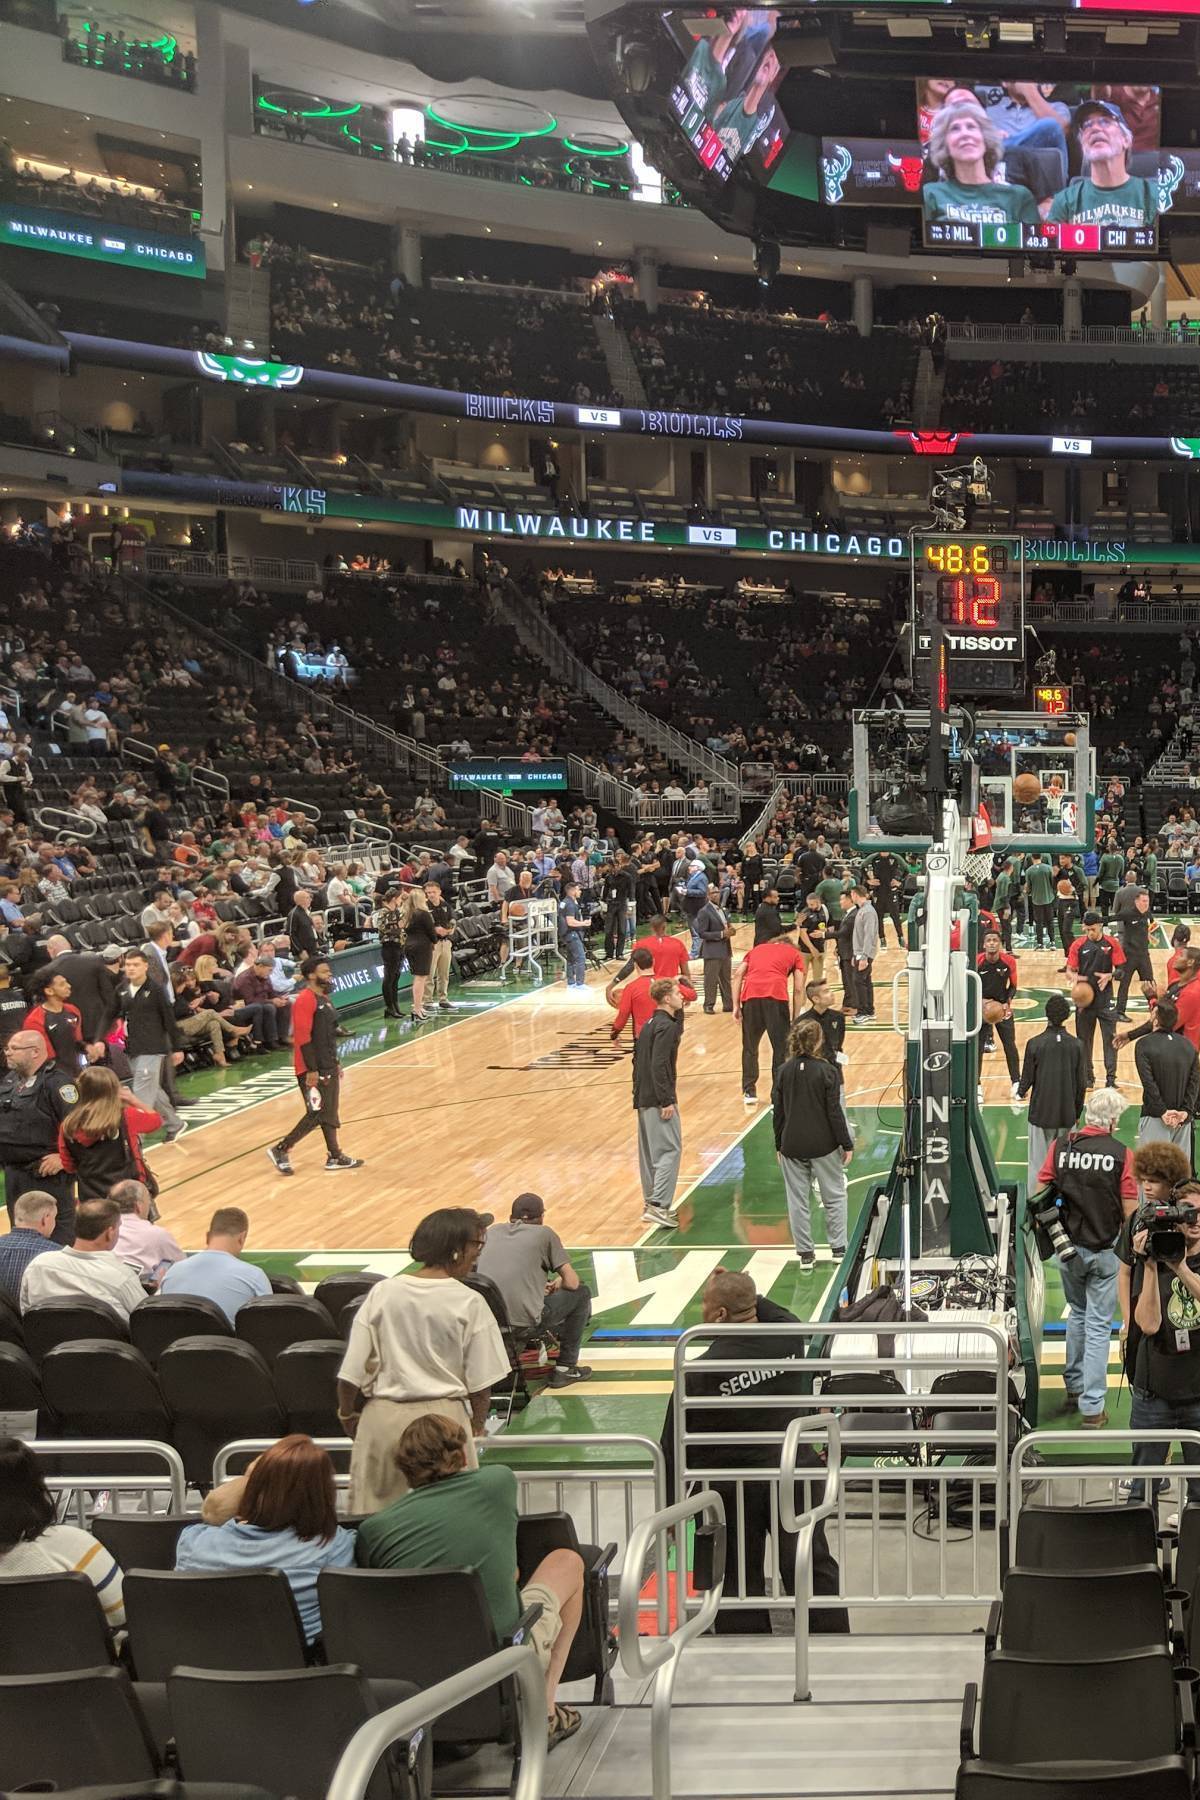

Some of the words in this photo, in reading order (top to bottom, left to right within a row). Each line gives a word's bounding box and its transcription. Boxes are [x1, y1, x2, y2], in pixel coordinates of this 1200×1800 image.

[1073, 204, 1144, 224] MILWAUKEE
[953, 226, 973, 241] MIL
[996, 227, 1007, 242] 0
[1046, 226, 1056, 235] 12
[1075, 229, 1085, 245] 0
[1108, 230, 1126, 245] CHI
[10, 221, 94, 245] MILWAUKEE
[136, 244, 194, 262] CHICAGO
[1026, 236, 1048, 247] 48.8
[466, 393, 555, 424] BUCKS
[590, 411, 608, 422] VS
[641, 409, 743, 440] BULLS
[1063, 440, 1081, 451] VS
[458, 507, 656, 541] MILWAUKEE
[702, 529, 723, 541] VS
[769, 530, 903, 556] CHICAGO
[927, 544, 989, 573] 48.6
[957, 576, 1000, 626] 12
[949, 636, 1018, 651] TISSOT
[1039, 690, 1061, 701] 48.6
[1049, 701, 1065, 714] 12
[453, 773, 503, 781] MILWAUKEE
[924, 1095, 950, 1204] NBA
